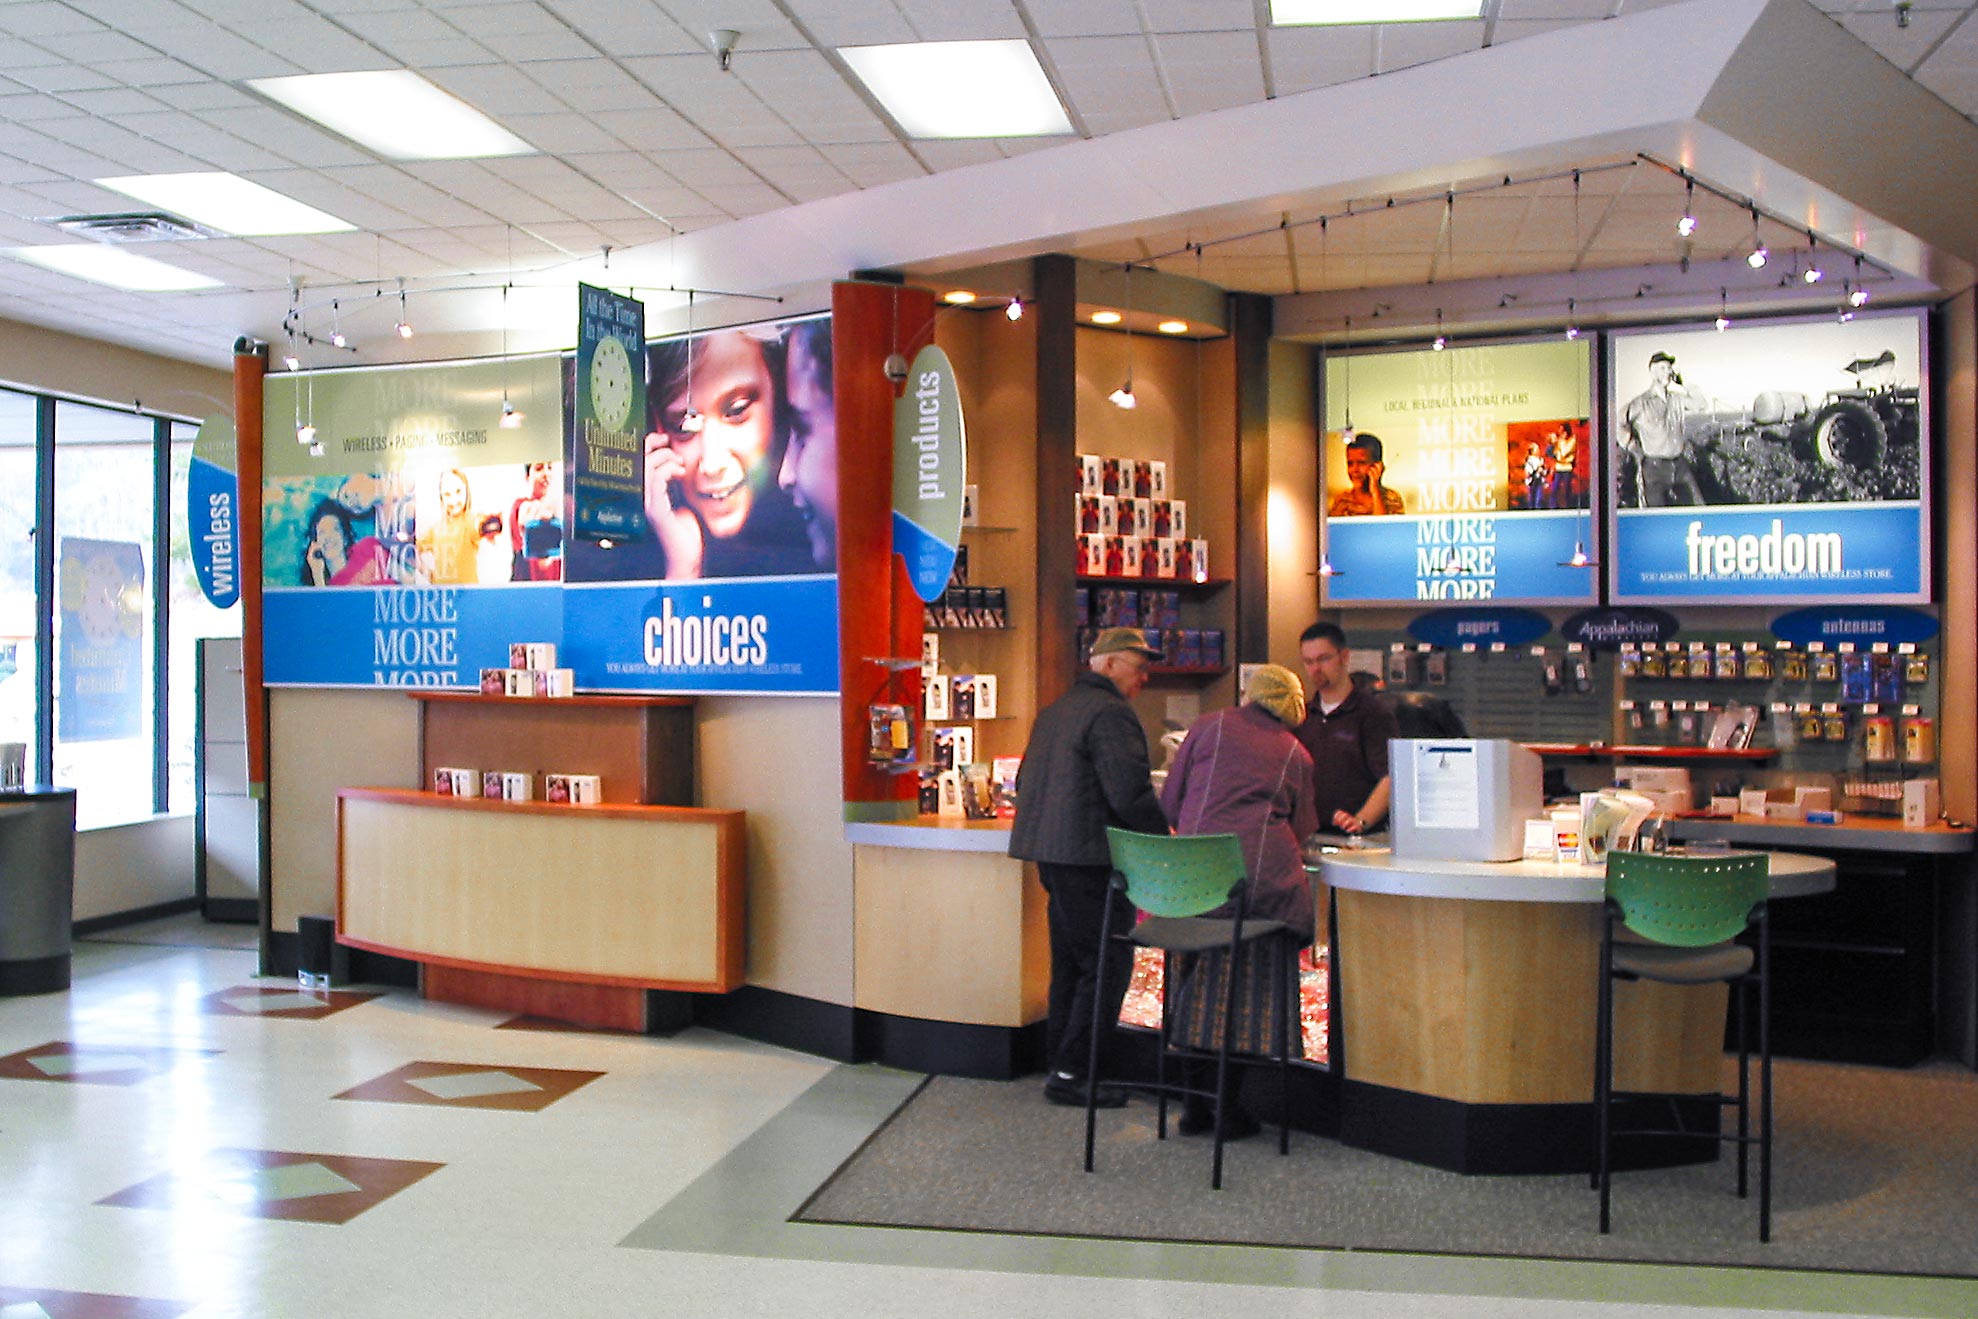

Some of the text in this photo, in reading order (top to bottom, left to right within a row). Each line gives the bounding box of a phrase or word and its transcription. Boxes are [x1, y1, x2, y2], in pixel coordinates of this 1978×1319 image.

[343, 436, 387, 453] WIRELESS
[437, 429, 488, 447] MESSAGING
[584, 417, 637, 453] Unlimited
[912, 371, 946, 501] products
[1417, 414, 1496, 444] MORE
[588, 446, 633, 478] Minutes
[1417, 446, 1496, 477] MORE
[1417, 480, 1496, 512] MORE
[203, 492, 234, 597] wireless
[1416, 517, 1496, 544] MORE
[1416, 547, 1496, 577] MORE
[1687, 518, 1843, 576] freedom
[373, 588, 458, 623] MORE
[643, 595, 768, 667] choices
[1578, 619, 1659, 641] Appalachian
[1822, 619, 1885, 634] antennas
[373, 628, 458, 666] MORE
